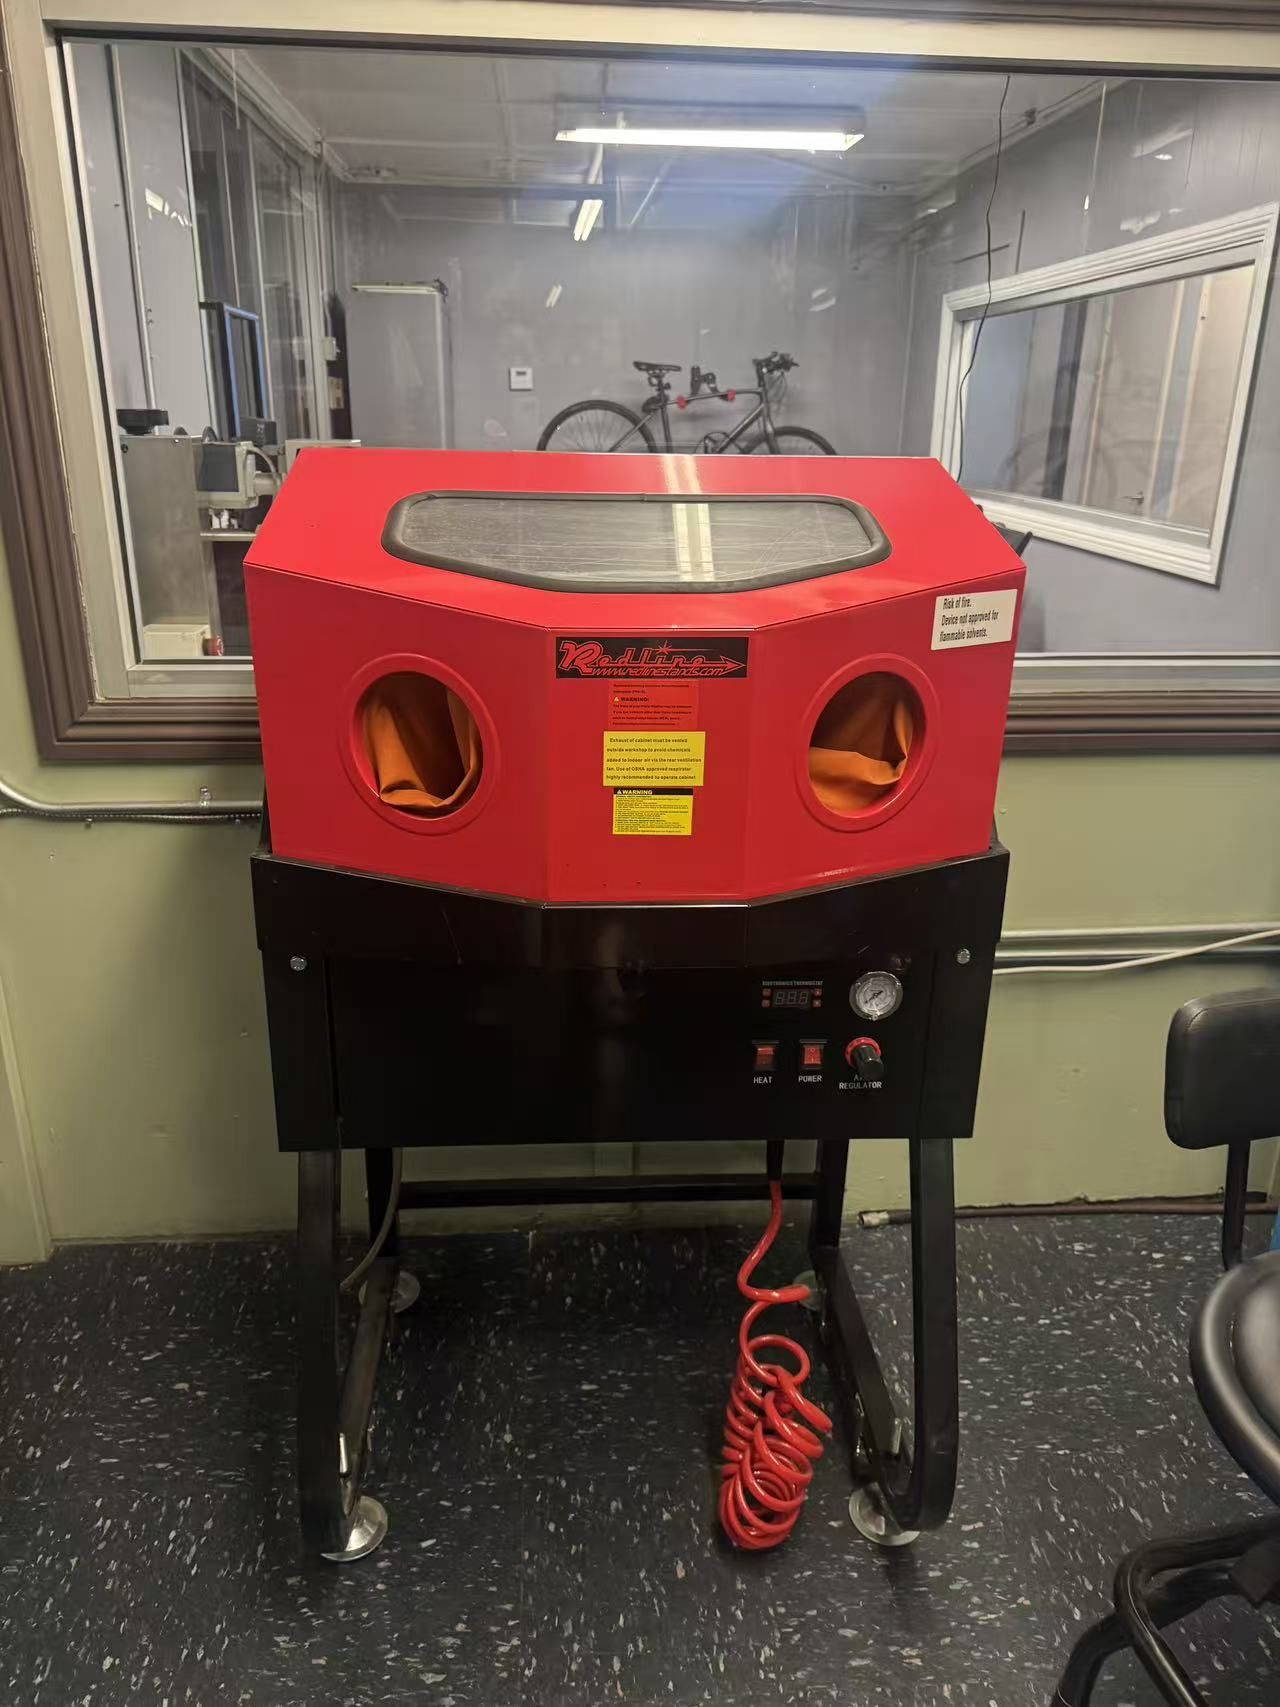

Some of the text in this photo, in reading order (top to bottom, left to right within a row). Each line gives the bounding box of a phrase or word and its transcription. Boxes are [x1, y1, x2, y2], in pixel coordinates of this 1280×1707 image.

[943, 597, 972, 610] Risk of fire.
[941, 614, 958, 626] Device
[959, 613, 968, 624] not
[968, 610, 991, 626] approved
[939, 628, 988, 642] flammable solvents.
[754, 1076, 773, 1084] HEAT
[798, 1075, 823, 1083] POWER
[838, 1081, 882, 1090] REGULATOR
